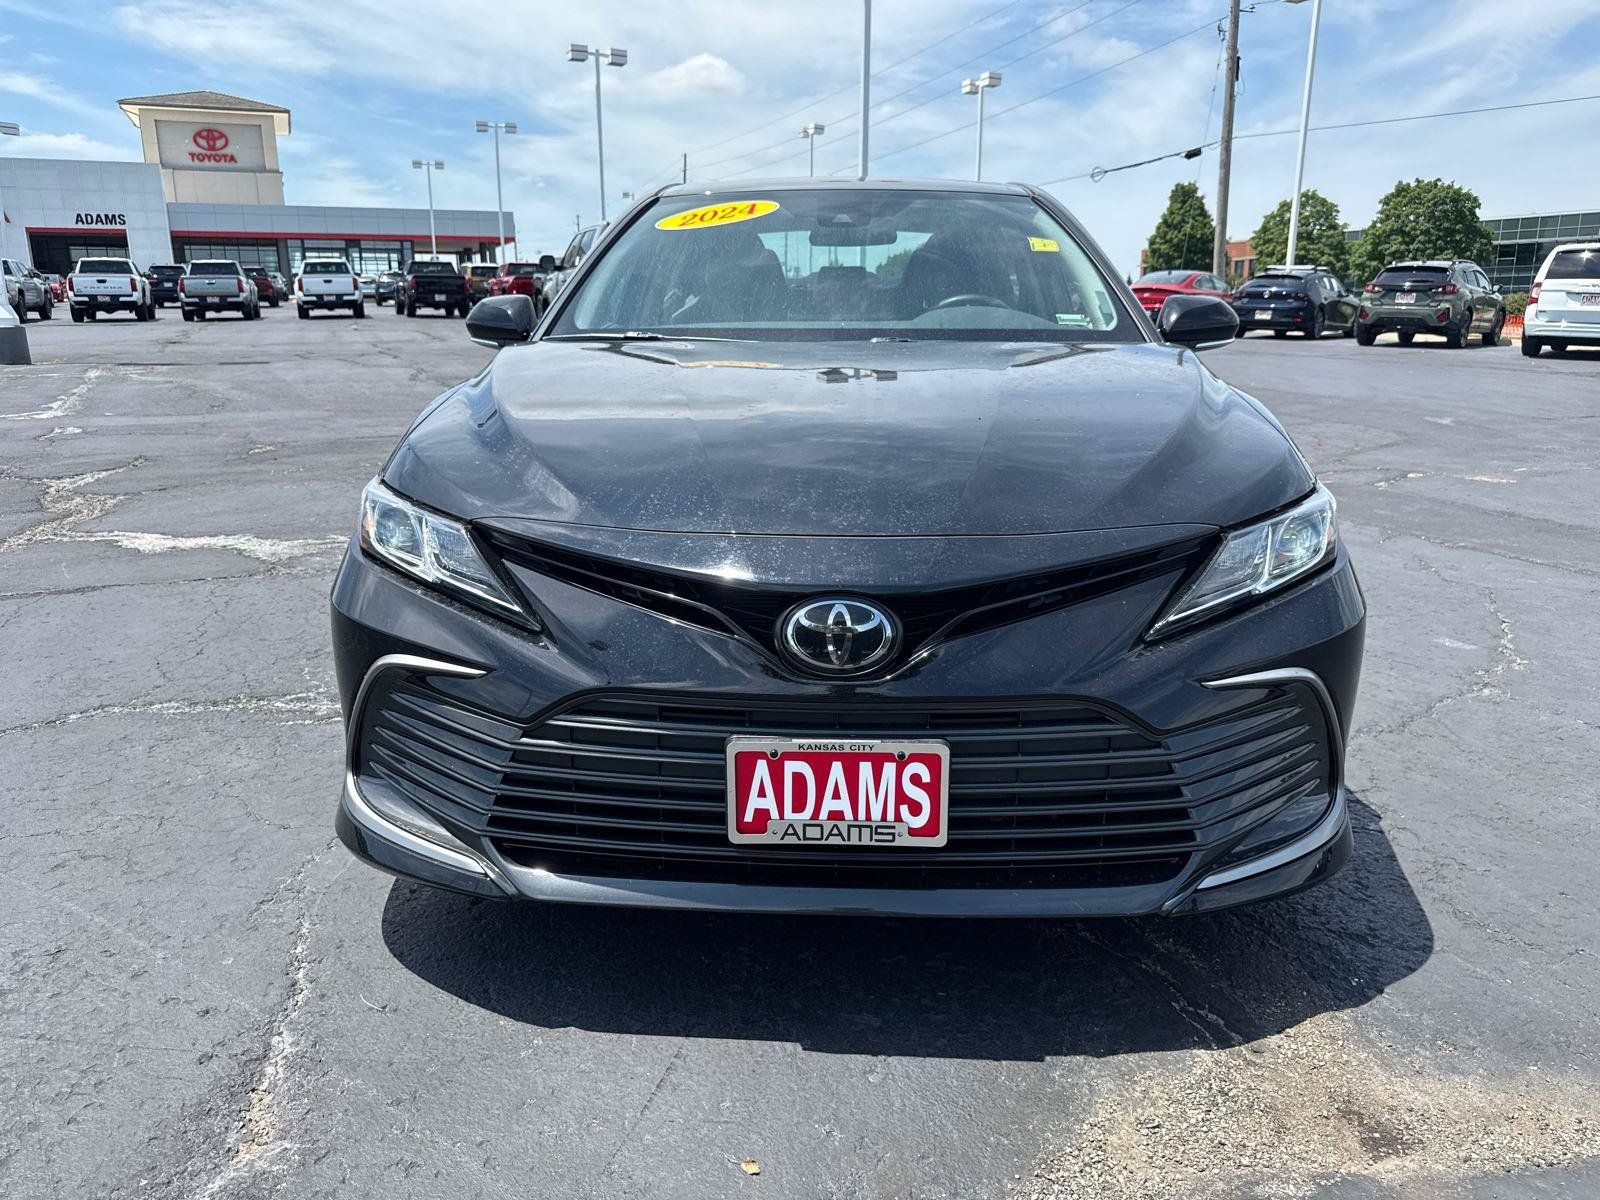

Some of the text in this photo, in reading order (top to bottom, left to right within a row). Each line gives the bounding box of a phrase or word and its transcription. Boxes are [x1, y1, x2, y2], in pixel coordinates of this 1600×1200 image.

[188, 152, 238, 164] TOYOTA
[75, 213, 127, 226] ADAMS
[678, 203, 757, 227] 2024
[798, 743, 876, 752] KANSAS CITY
[743, 759, 931, 828] ADAMS
[779, 823, 897, 843] ADAMS
